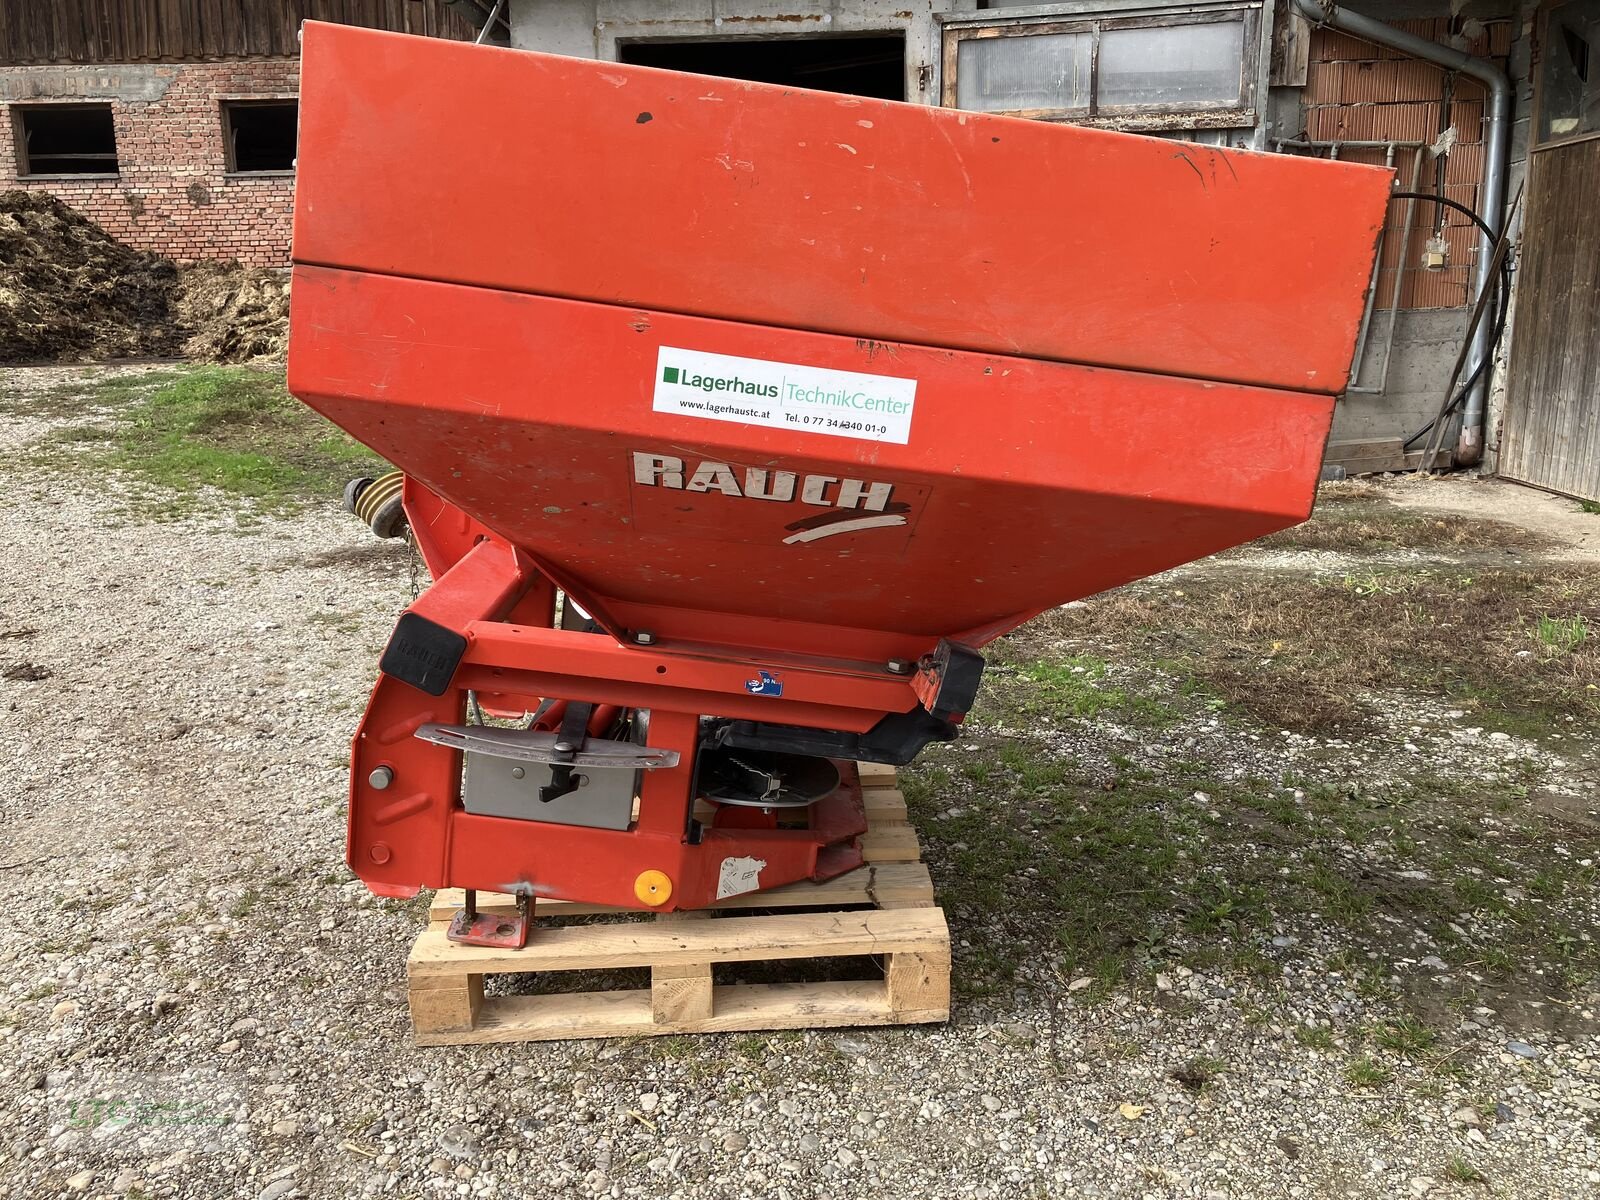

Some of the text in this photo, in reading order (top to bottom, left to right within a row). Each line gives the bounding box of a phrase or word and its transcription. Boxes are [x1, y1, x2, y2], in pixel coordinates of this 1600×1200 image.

[681, 369, 911, 415] Lagerhaus TechnikCenter
[679, 400, 771, 419] www.lagerhaustc.at
[785, 413, 801, 423] Tel.
[803, 415, 810, 424] 0
[812, 416, 824, 426] 77
[864, 423, 887, 434] 01-0
[633, 451, 894, 512] RAUCH
